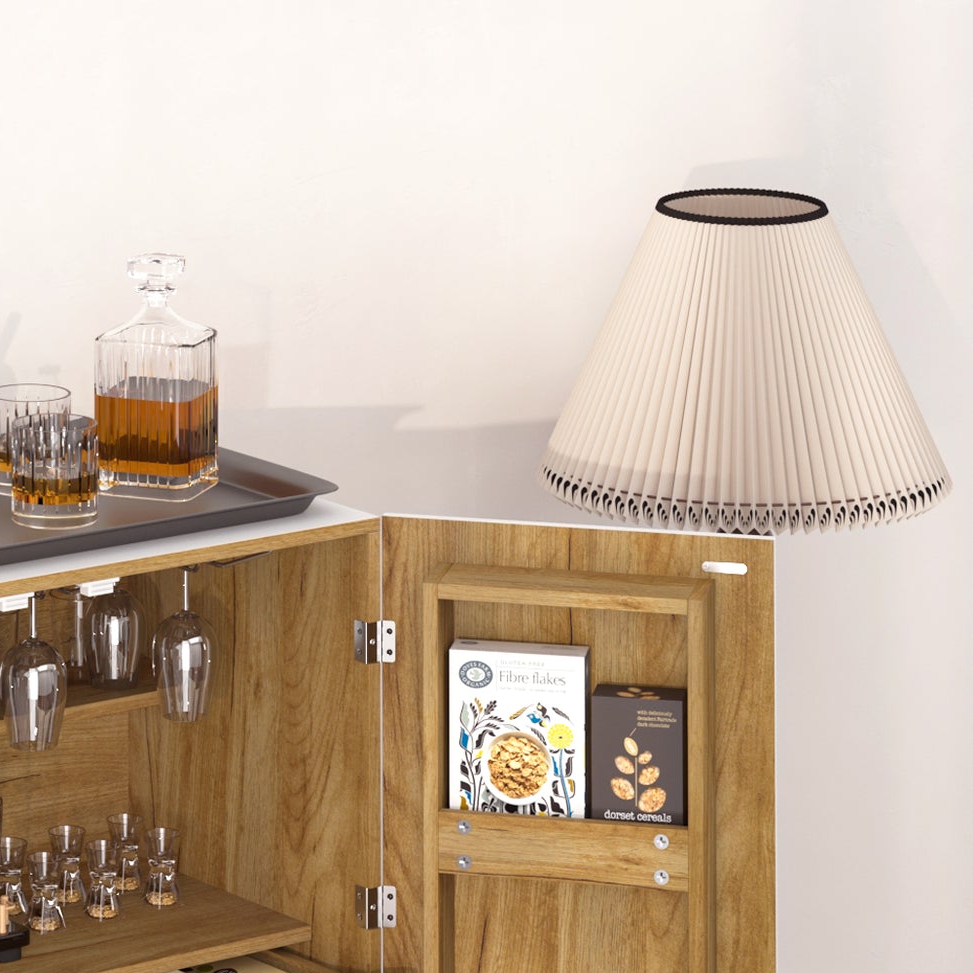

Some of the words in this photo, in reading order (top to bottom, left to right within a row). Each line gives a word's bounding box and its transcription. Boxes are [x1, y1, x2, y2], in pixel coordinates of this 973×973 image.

[499, 670, 529, 684] Fibre
[532, 671, 566, 687] flakes
[603, 809, 636, 821] dorset
[636, 812, 672, 823] cereals
